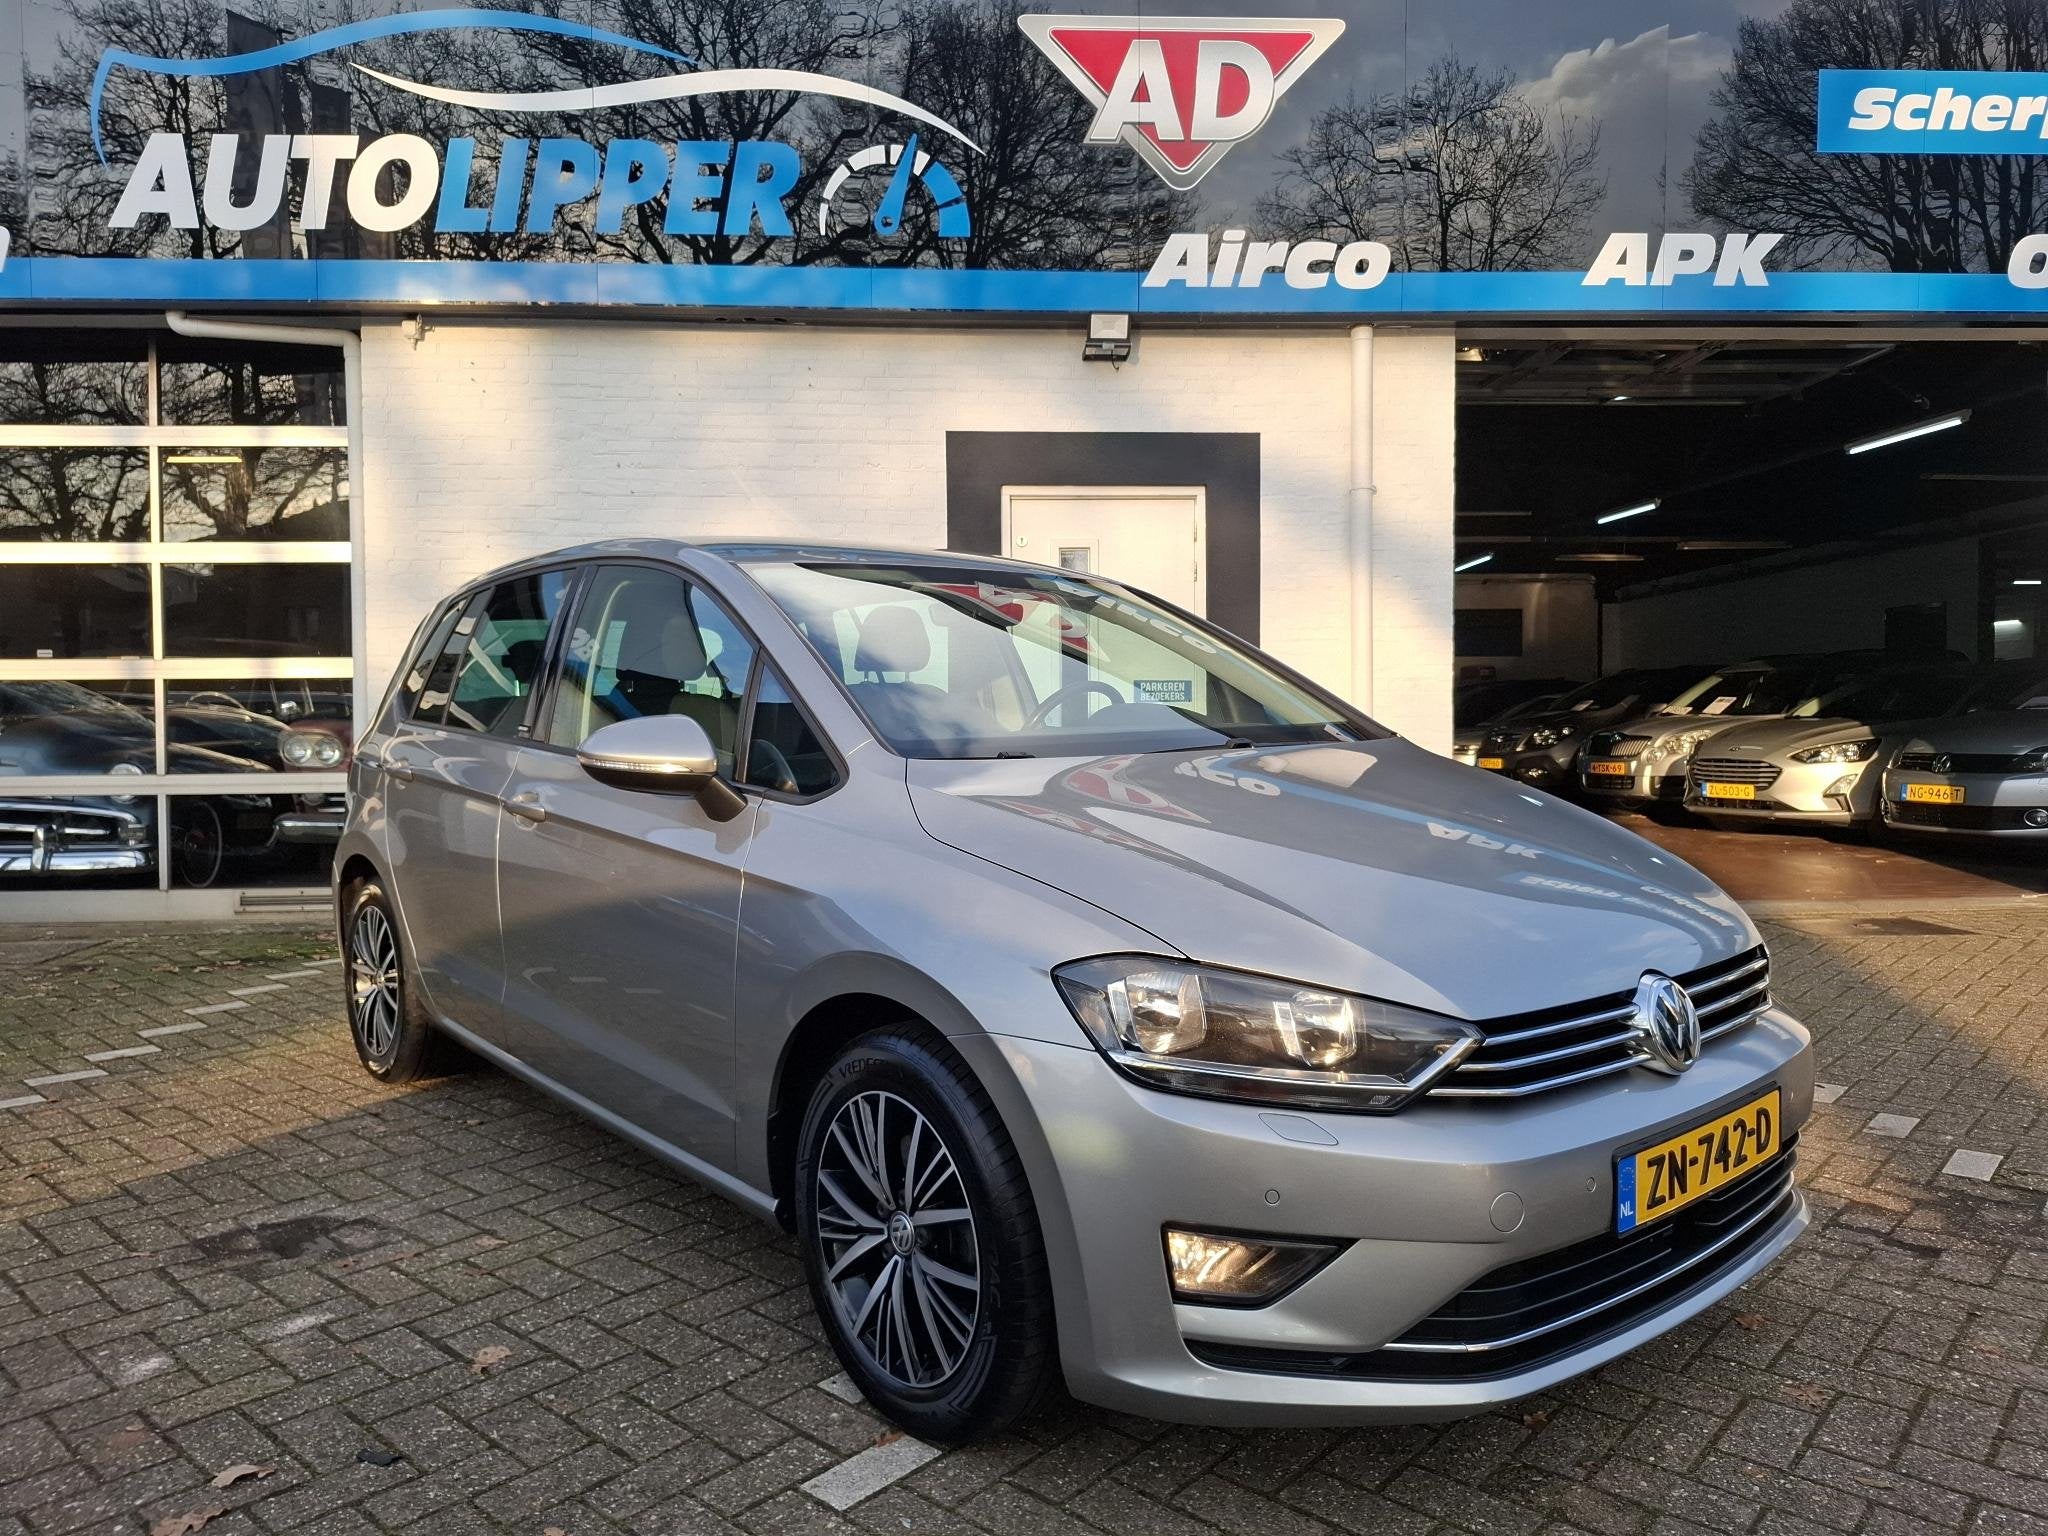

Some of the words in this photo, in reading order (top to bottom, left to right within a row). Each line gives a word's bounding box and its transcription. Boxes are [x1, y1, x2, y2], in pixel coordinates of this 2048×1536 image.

[1090, 40, 1275, 142] AD
[1848, 87, 2048, 139] Scher
[1141, 229, 1392, 290] Airco
[1581, 233, 1784, 287] APK
[1140, 682, 1185, 692] PARKEREN
[1140, 692, 1185, 701] BEZOEKERS
[1709, 785, 1750, 797] ZL-503-G
[1909, 787, 1961, 801] NG-946-T
[1646, 1106, 1772, 1211] ZN-742-D
[1620, 1200, 1634, 1219] NL
